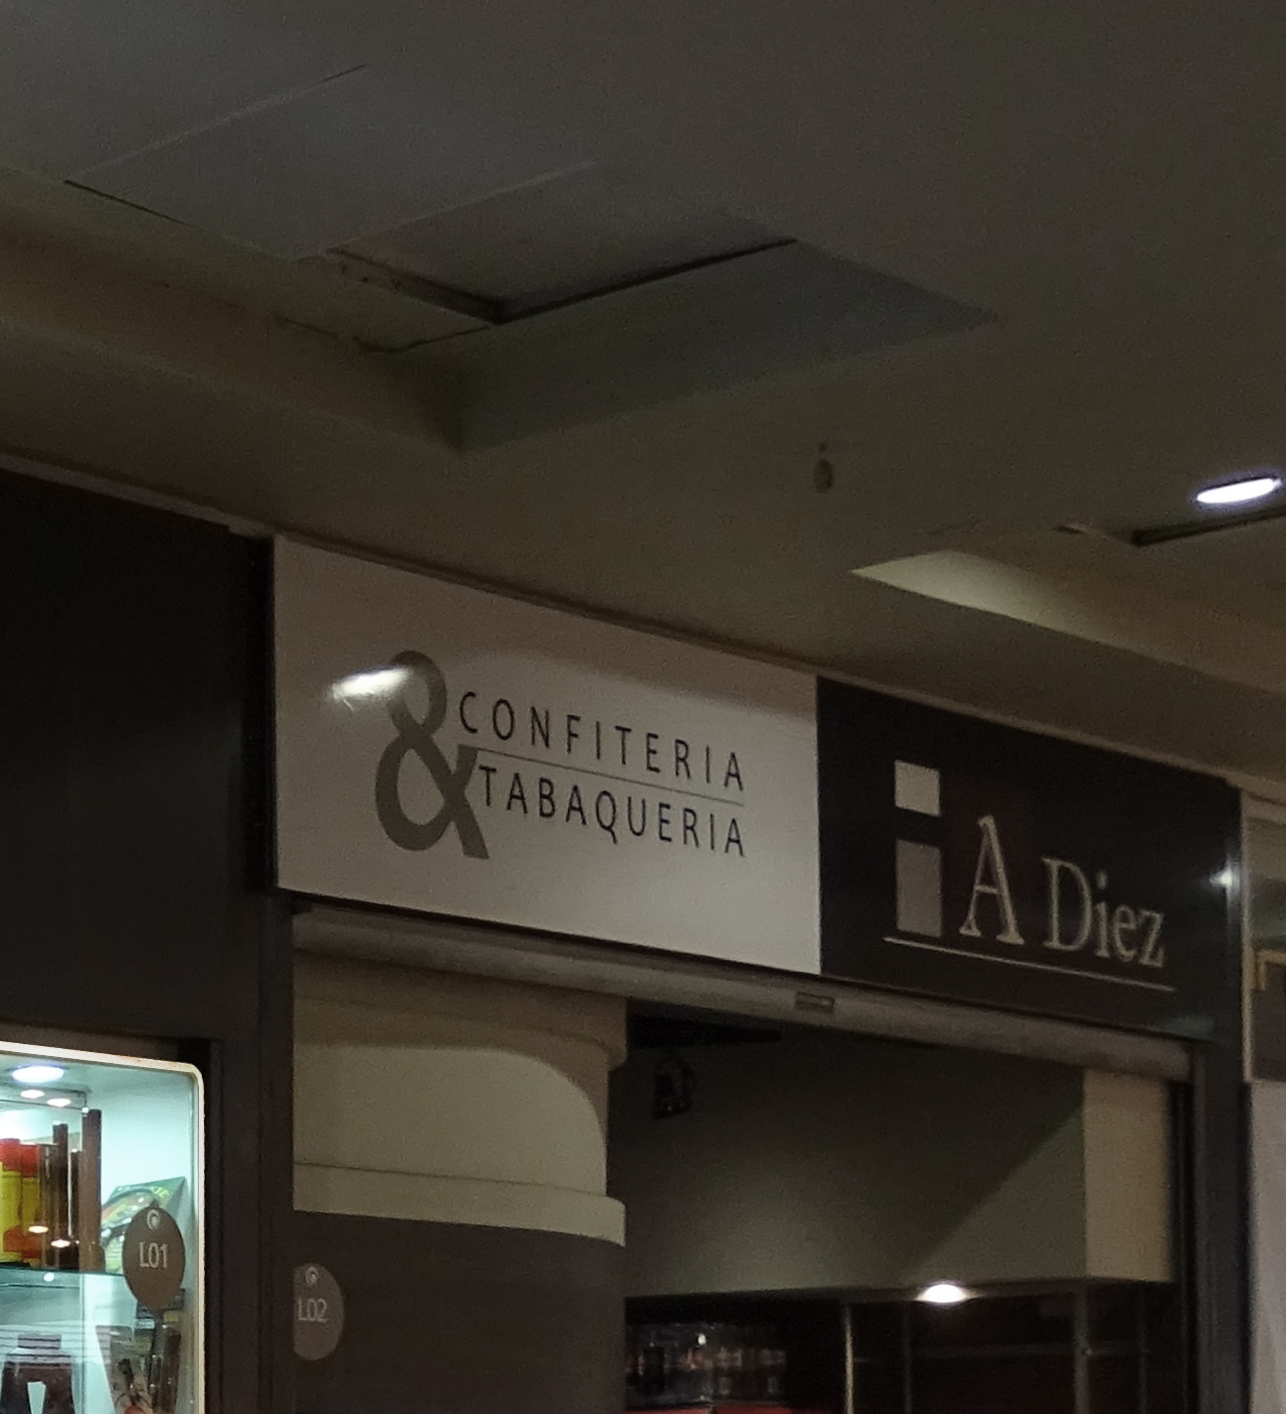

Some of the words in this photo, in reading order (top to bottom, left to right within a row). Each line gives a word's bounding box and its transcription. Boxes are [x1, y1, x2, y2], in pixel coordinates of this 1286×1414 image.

[458, 689, 746, 793] CONFITERIA
[477, 764, 747, 859] TABAQUERIA
[1042, 857, 1167, 971] Diez
[138, 1241, 169, 1269] L01
[297, 1297, 328, 1322] L02
